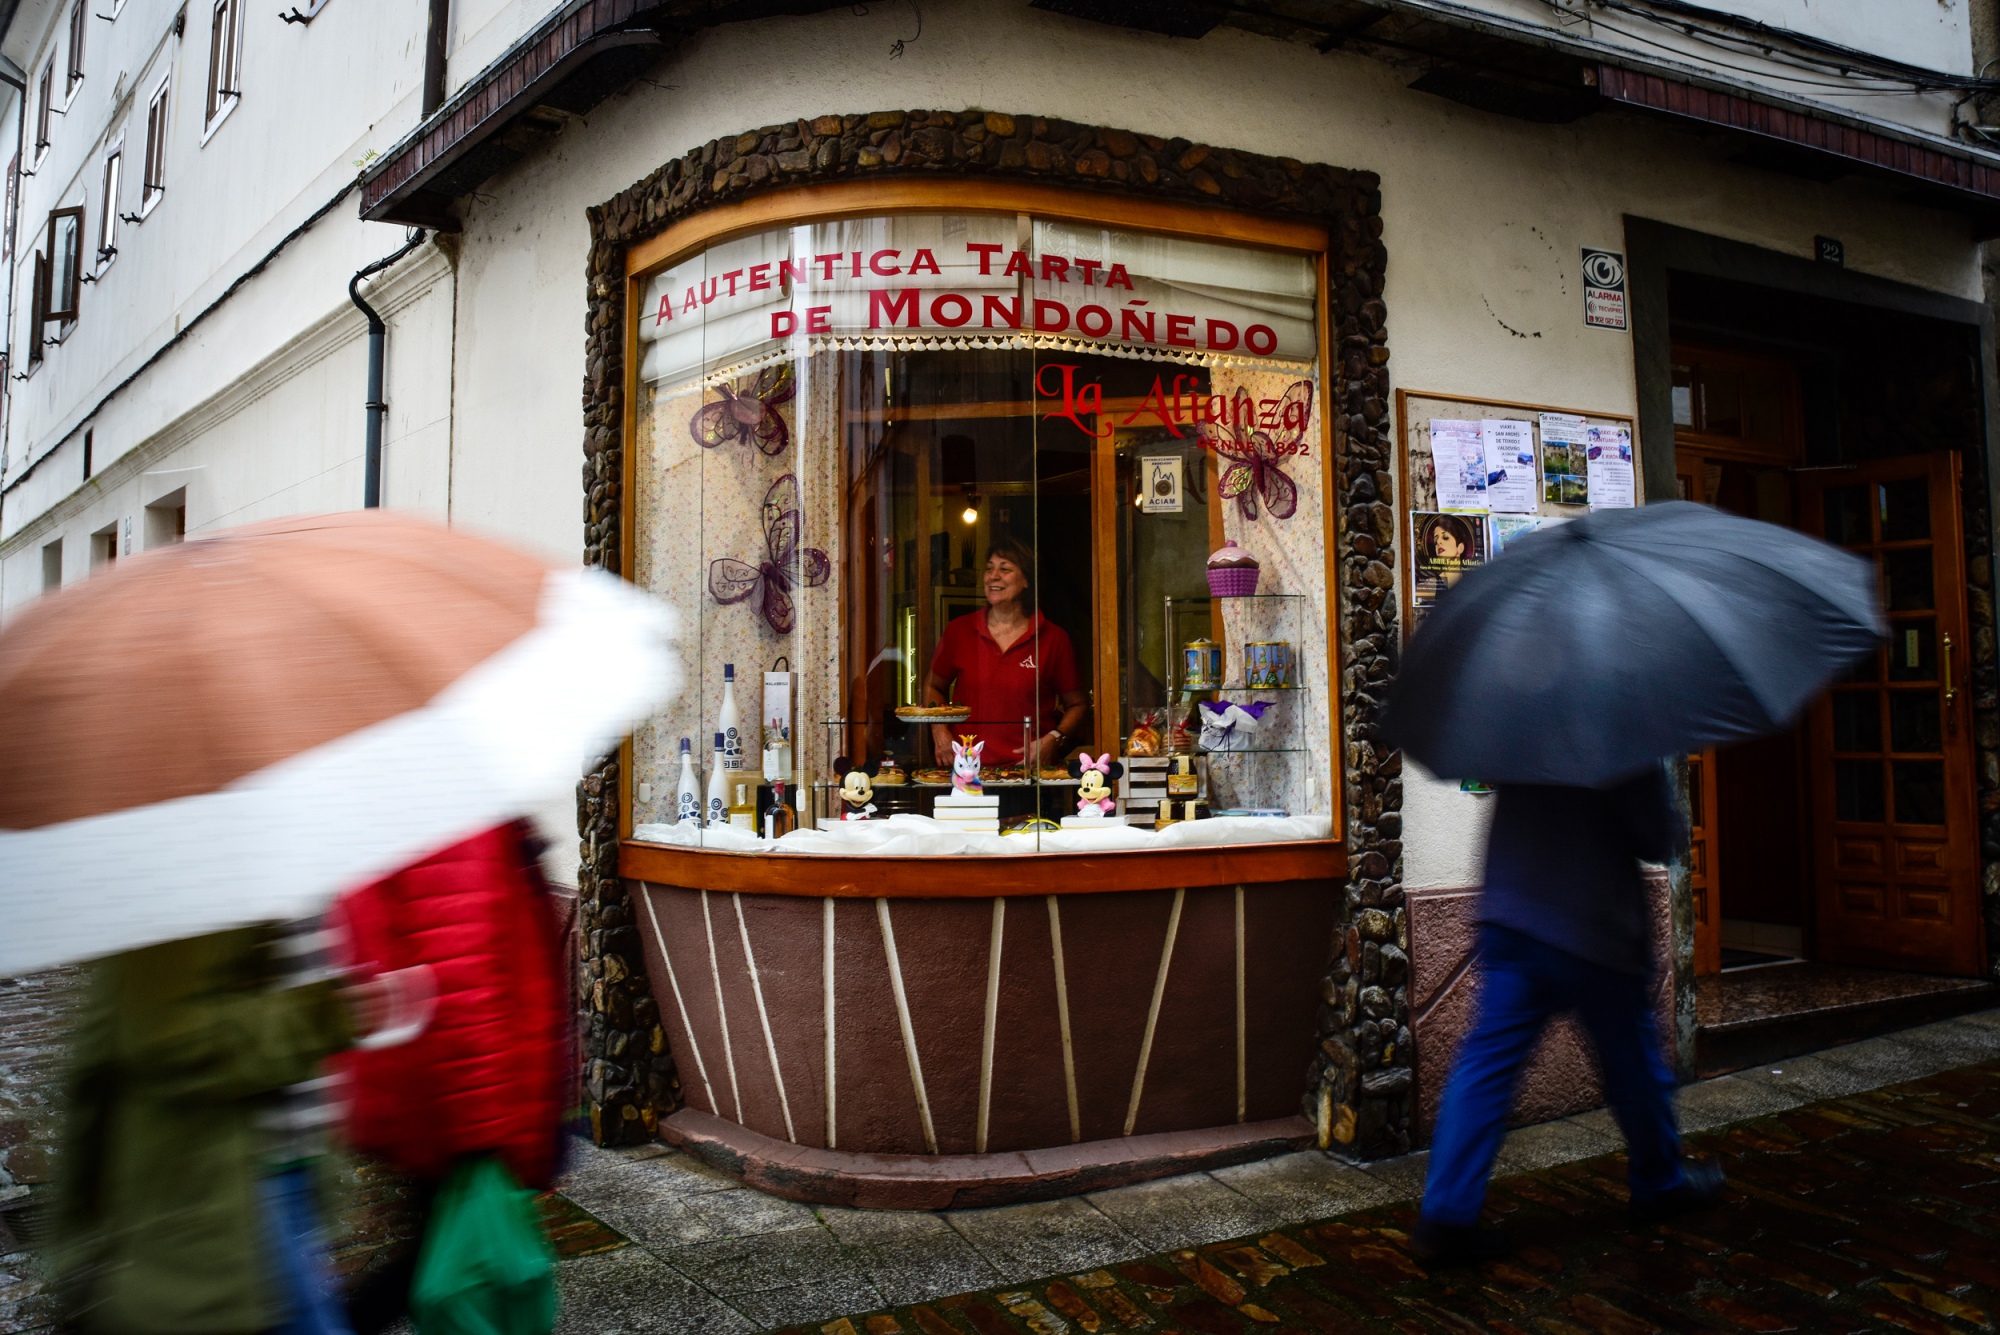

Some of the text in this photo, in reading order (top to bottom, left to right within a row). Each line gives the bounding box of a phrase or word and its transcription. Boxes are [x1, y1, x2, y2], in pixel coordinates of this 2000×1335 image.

[1822, 242, 1839, 262] 22
[656, 242, 1134, 327] A AUTENTICA TARTA
[1588, 290, 1622, 302] ALARMA
[770, 288, 1279, 357] DE MONDOÑEDO
[1036, 363, 1309, 440] La Alianza
[1197, 438, 1310, 456] DENDE 1892
